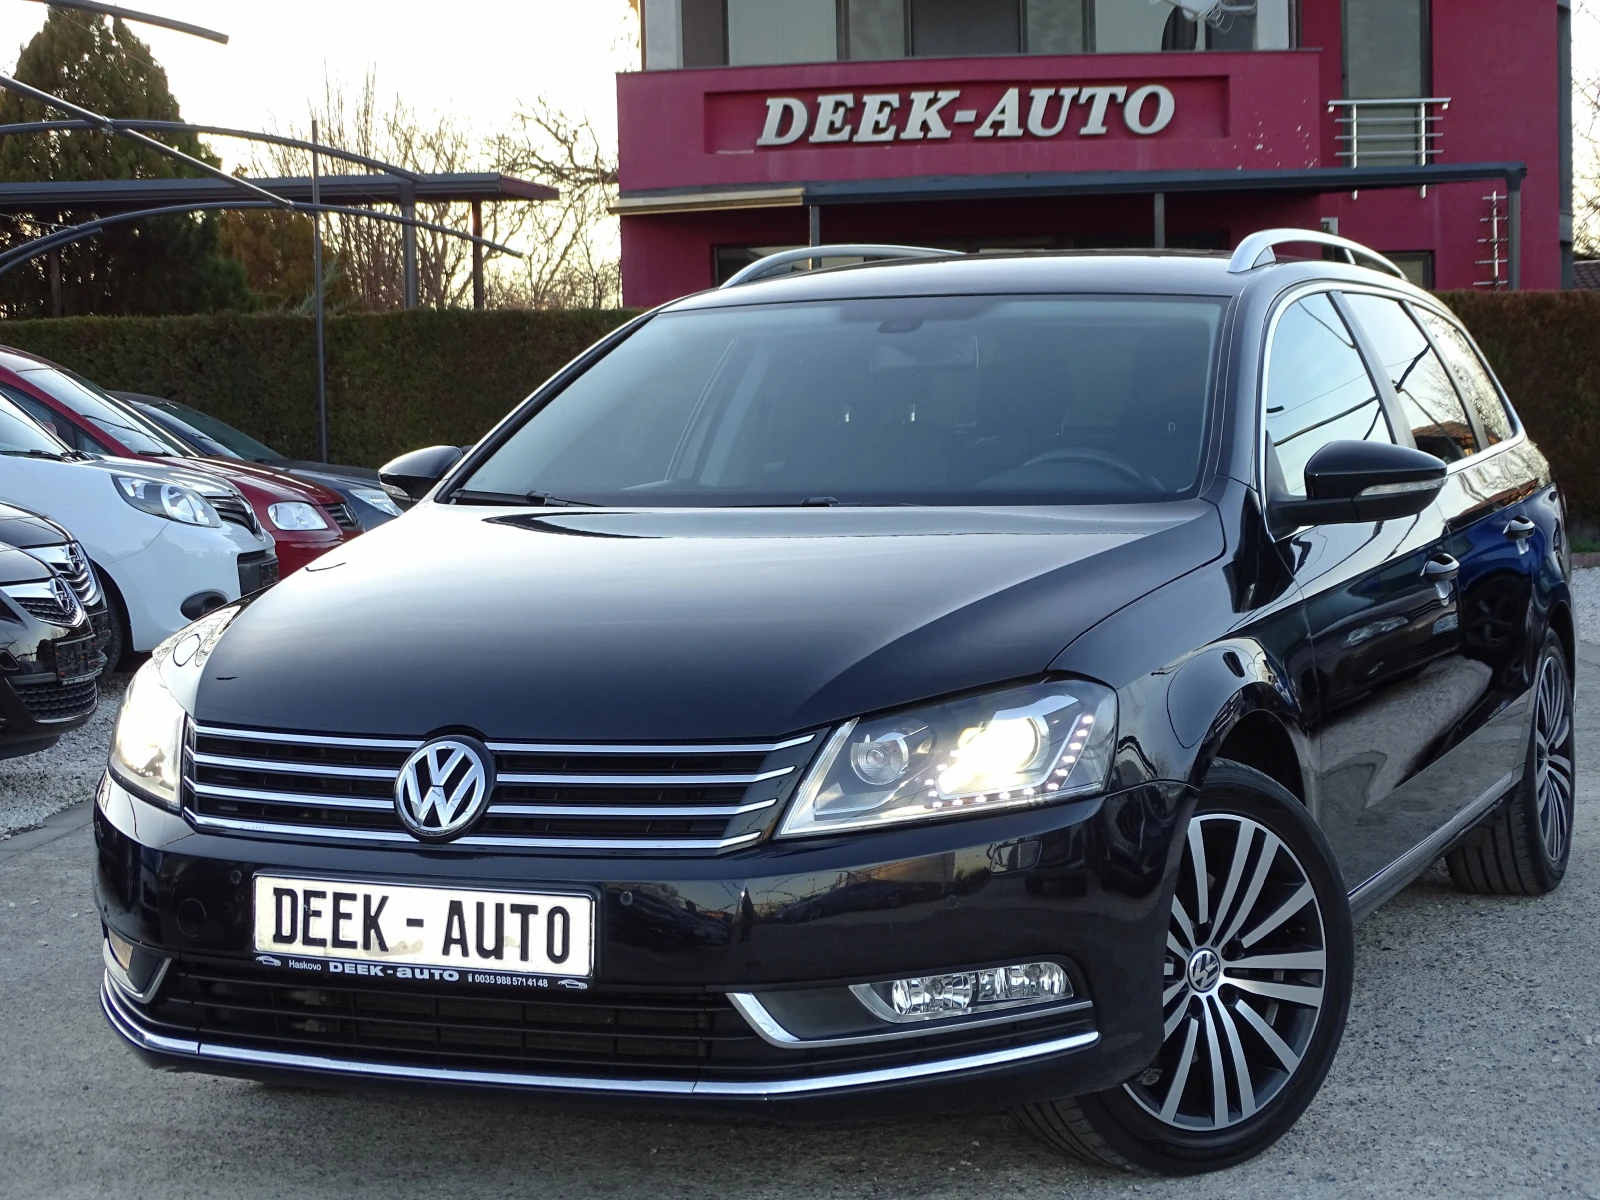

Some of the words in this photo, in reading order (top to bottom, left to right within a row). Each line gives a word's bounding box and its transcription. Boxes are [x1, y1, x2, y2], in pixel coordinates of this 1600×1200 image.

[756, 85, 1175, 146] DEEK-AUTO
[272, 886, 390, 952] DEEK
[442, 900, 571, 964] AUTO
[288, 959, 322, 971] Haskovo
[475, 974, 495, 984] 0035
